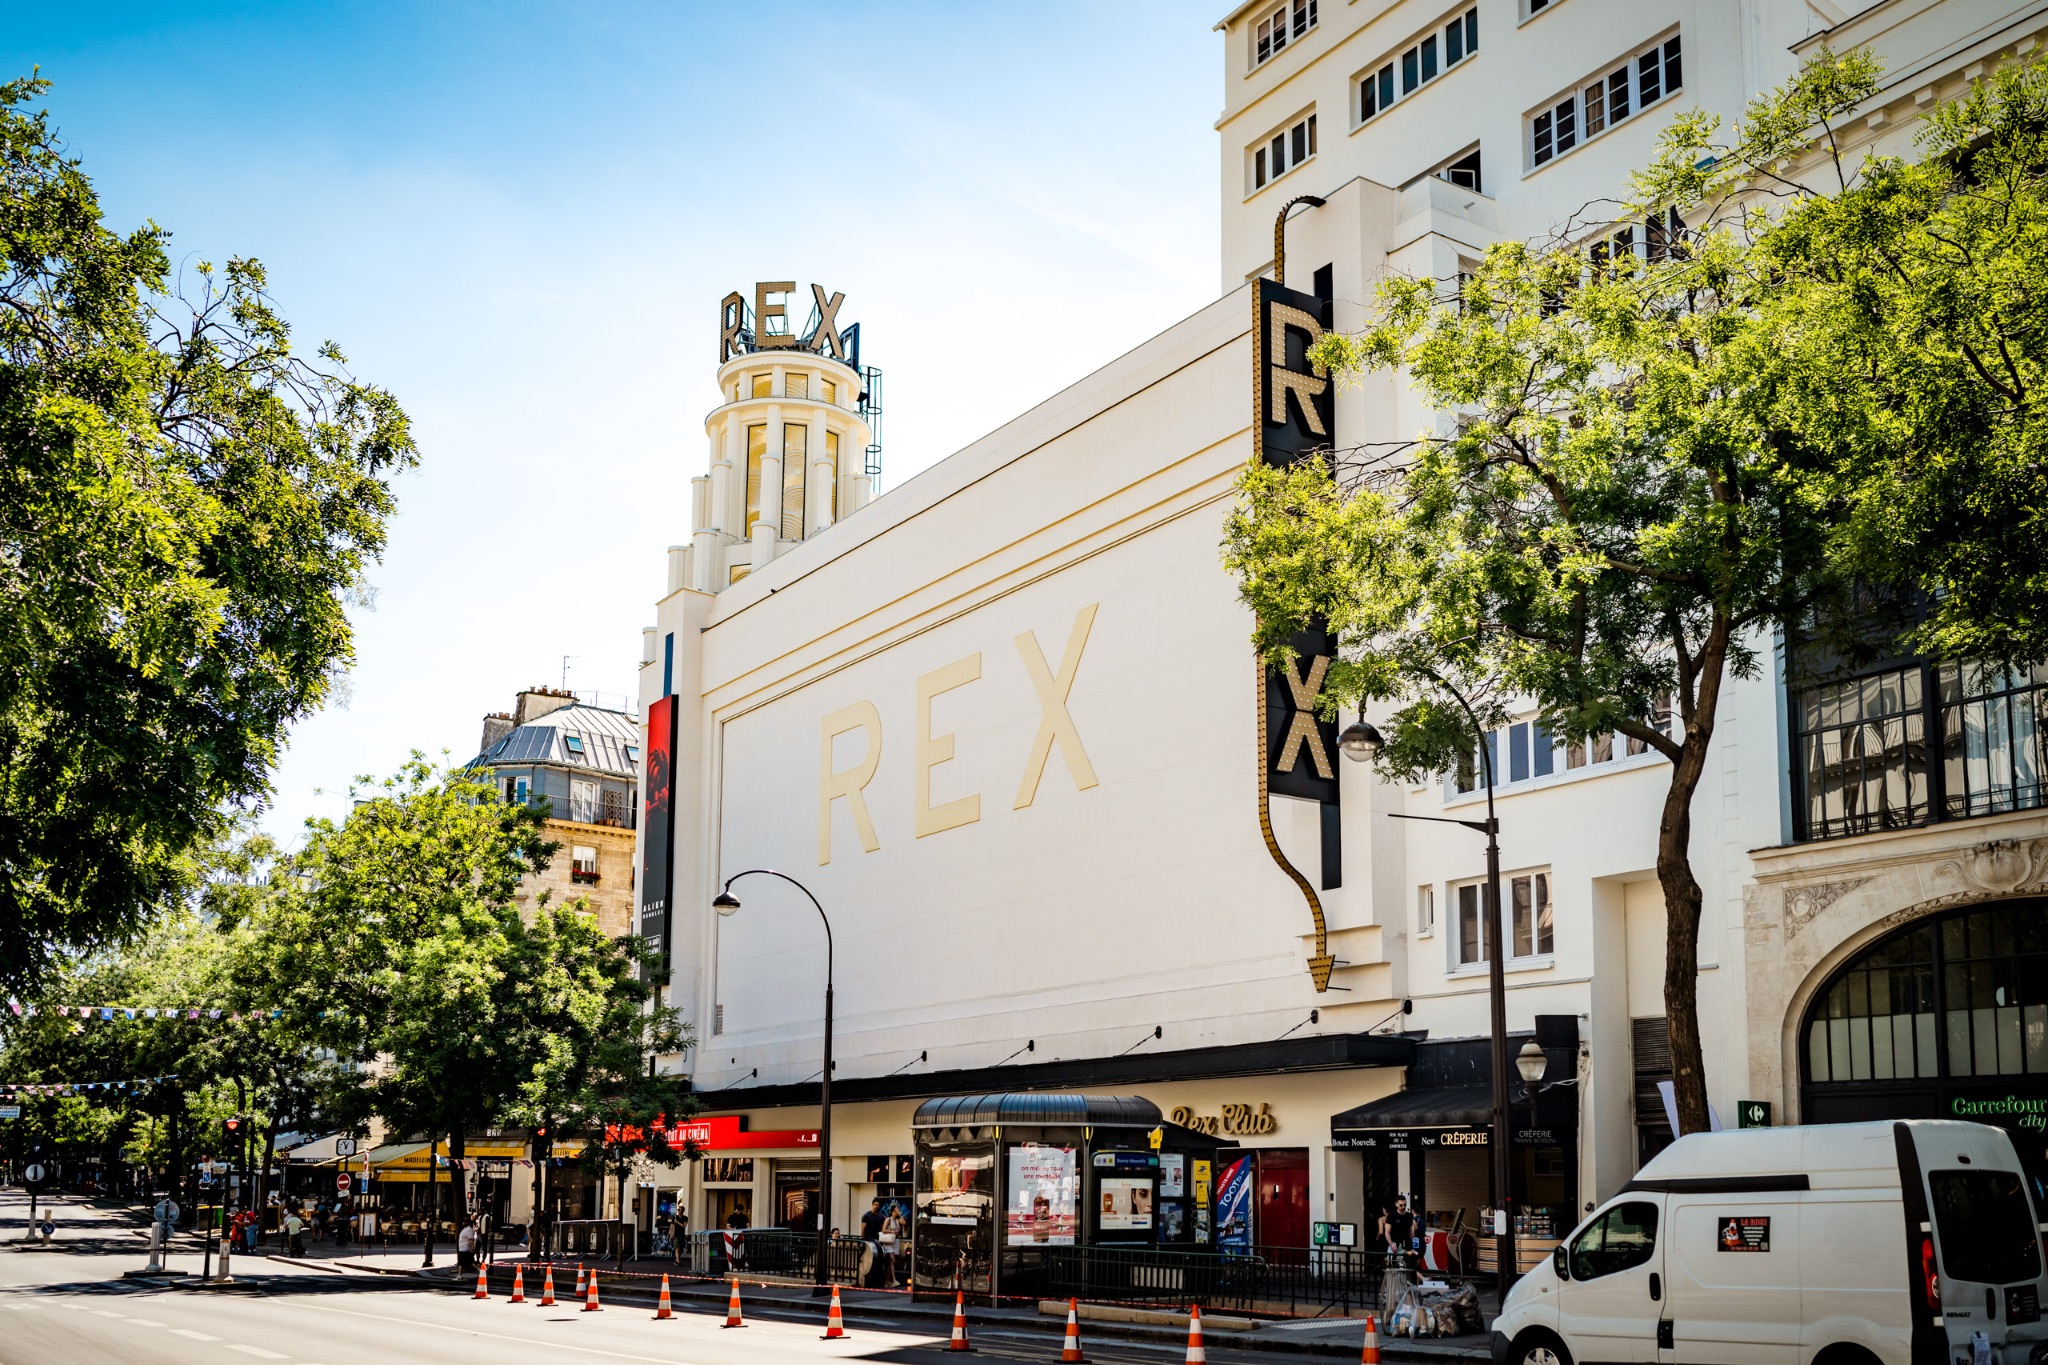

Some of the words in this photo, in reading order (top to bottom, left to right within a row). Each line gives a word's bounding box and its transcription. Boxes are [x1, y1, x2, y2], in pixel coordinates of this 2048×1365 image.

[720, 281, 846, 363] REX
[818, 602, 1099, 866] REX
[643, 900, 664, 912] ALIEN
[1952, 1095, 2048, 1115] Carrefour
[1170, 1106, 1219, 1135] Rex
[1221, 1103, 1277, 1135] Club
[2019, 1114, 2047, 1133] city
[486, 1129, 502, 1137] BAR
[679, 1129, 687, 1141] AU
[1421, 1136, 1436, 1145] New
[1440, 1131, 1488, 1145] CRÊPERIE
